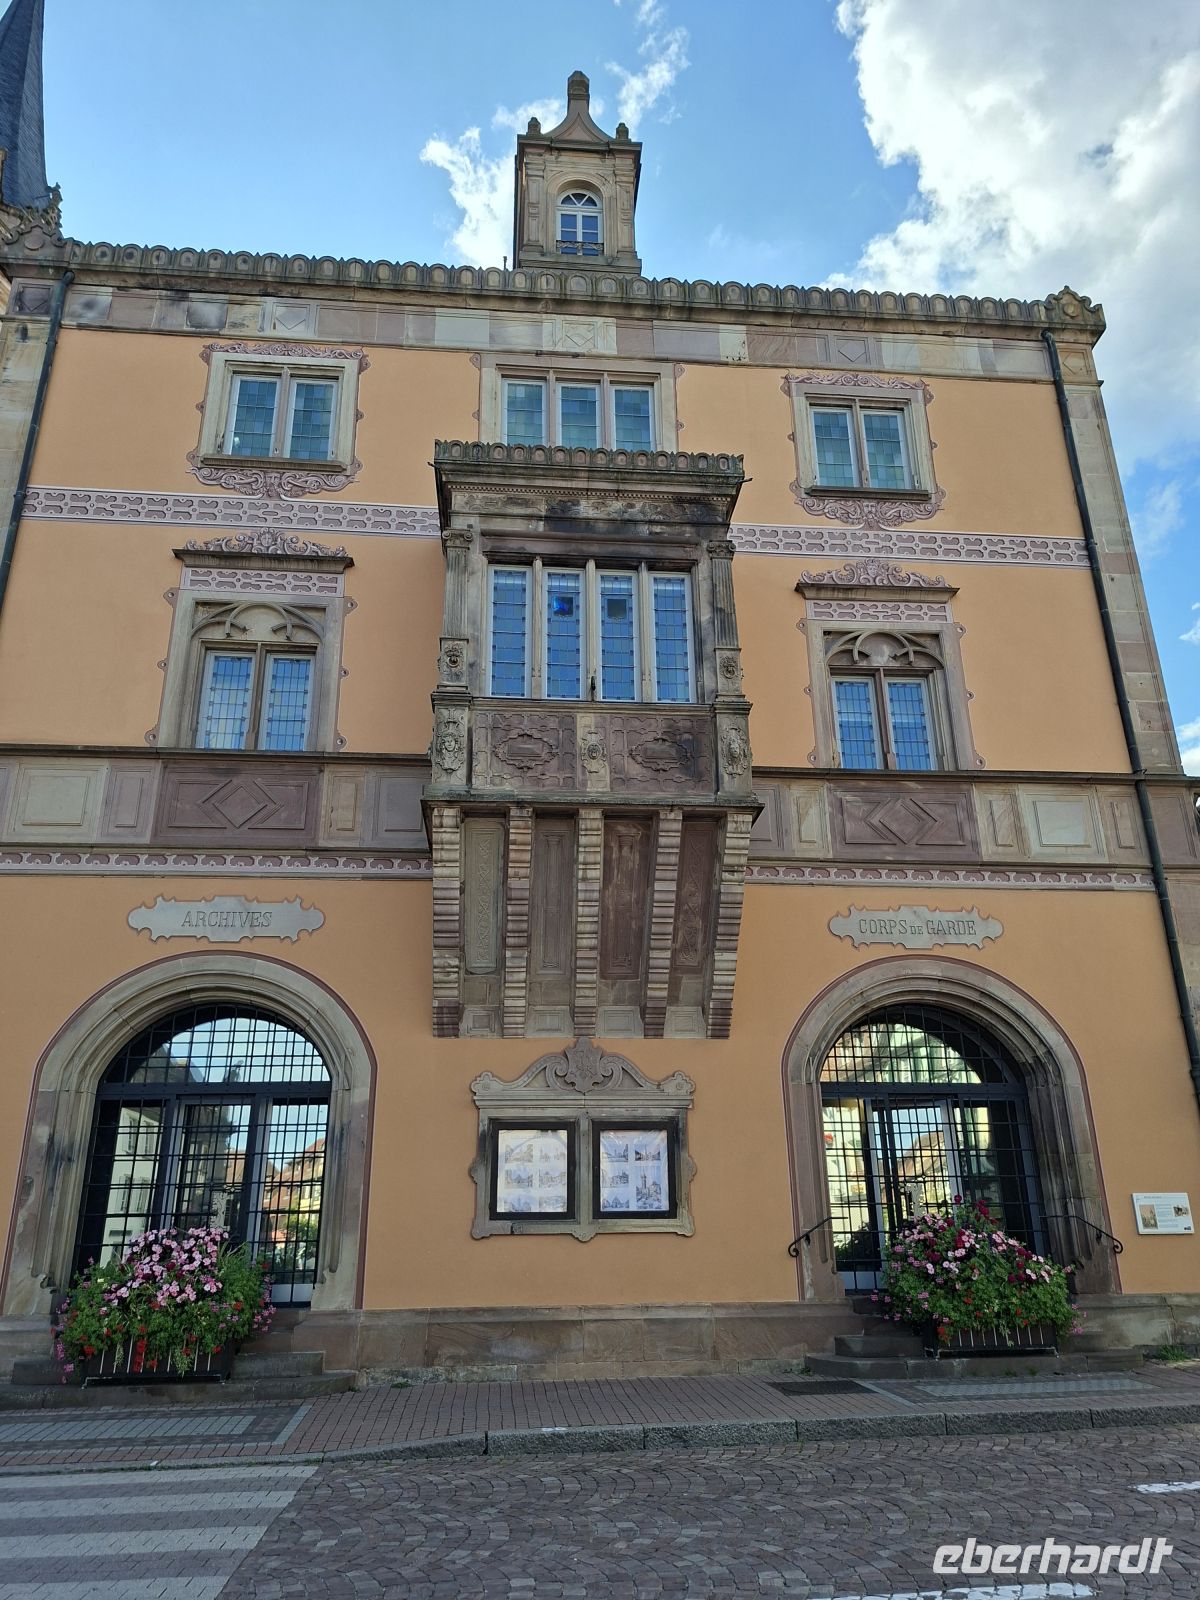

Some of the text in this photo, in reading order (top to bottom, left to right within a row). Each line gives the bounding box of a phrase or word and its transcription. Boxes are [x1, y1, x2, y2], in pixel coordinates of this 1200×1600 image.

[181, 911, 273, 928] ARCHIVES
[859, 919, 977, 936] CORPS DE GARDE
